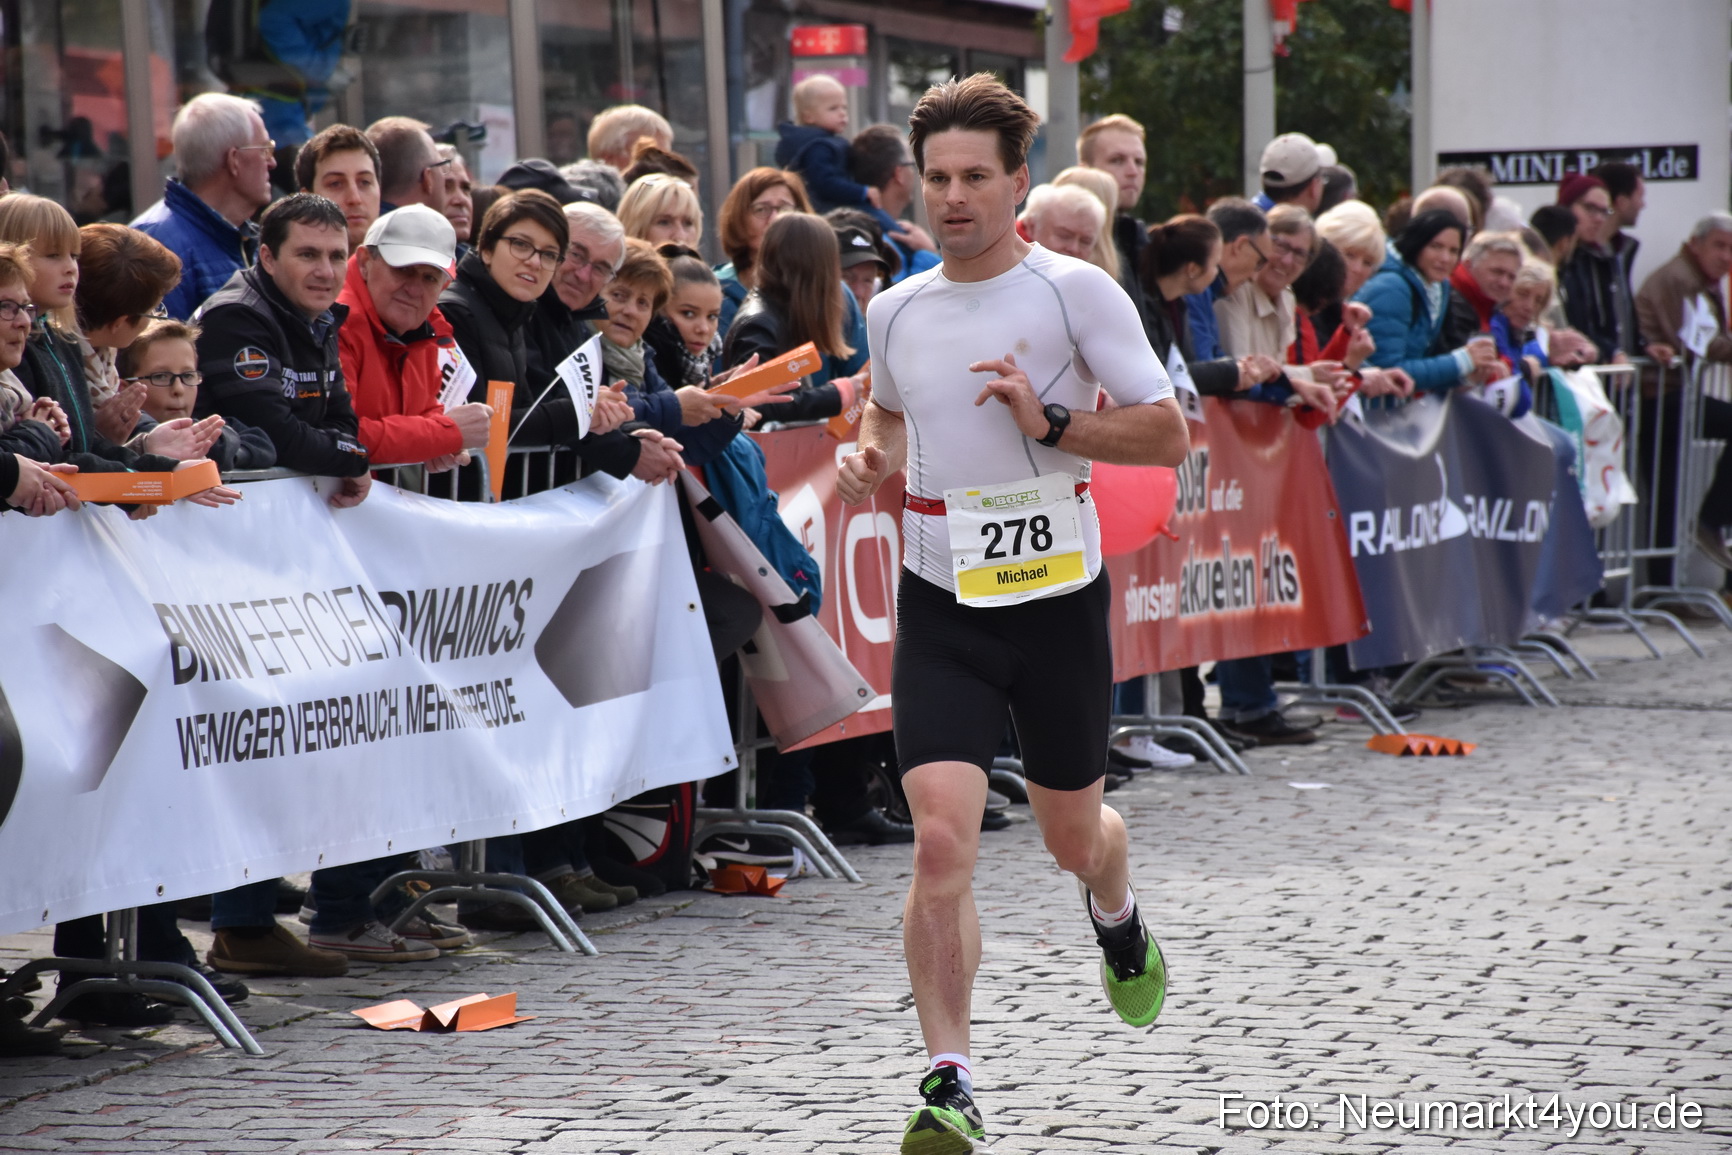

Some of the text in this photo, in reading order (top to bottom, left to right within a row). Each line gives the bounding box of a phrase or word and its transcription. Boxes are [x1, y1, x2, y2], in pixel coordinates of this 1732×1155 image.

[573, 352, 594, 400] swn
[995, 490, 1040, 507] BOCK
[981, 515, 1053, 560] 278
[997, 564, 1048, 585] Michael
[153, 602, 254, 686] BMW
[175, 706, 285, 770] WENIGER
[287, 687, 402, 754] VERBRAUCH.
